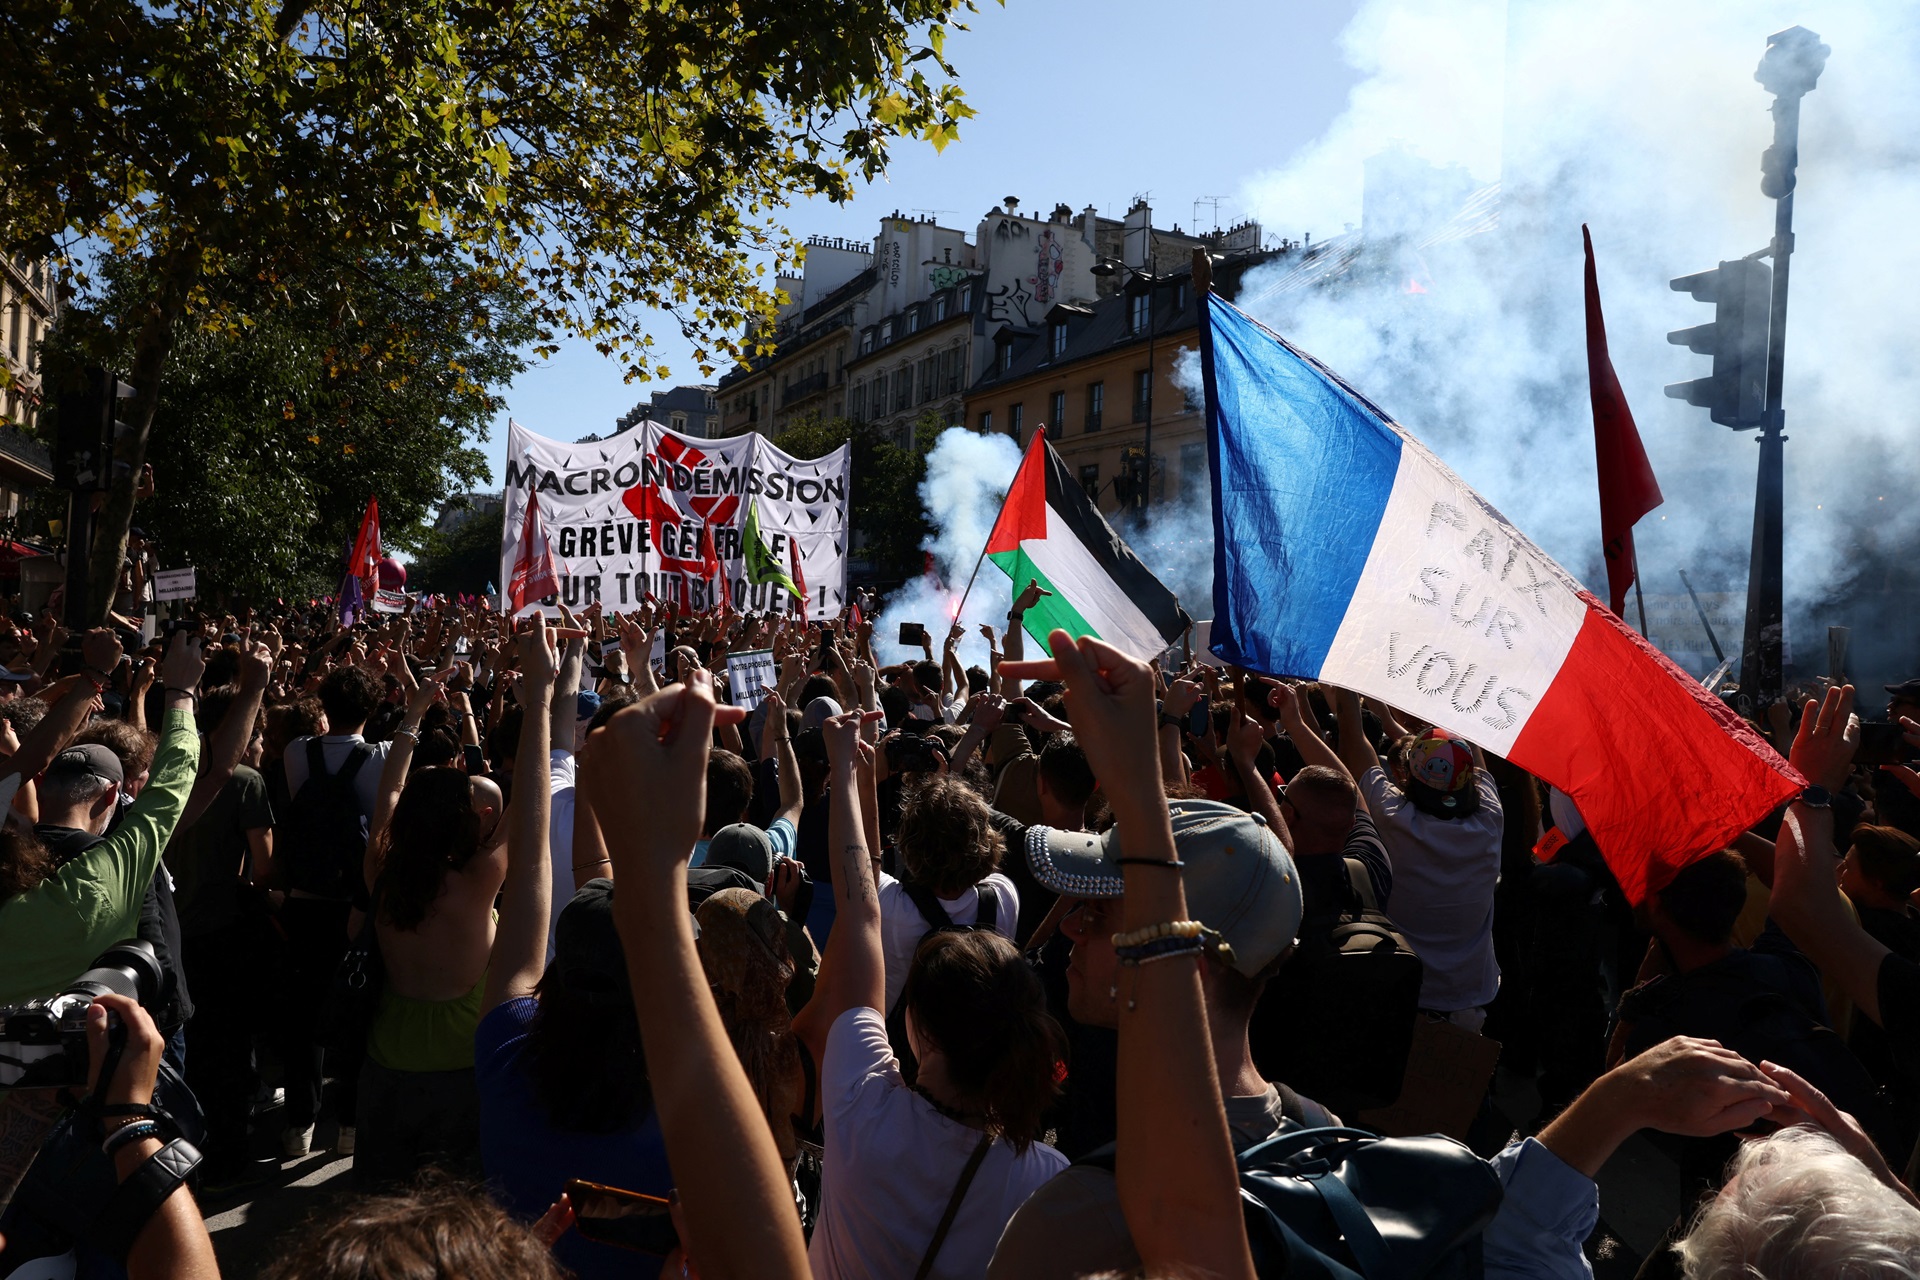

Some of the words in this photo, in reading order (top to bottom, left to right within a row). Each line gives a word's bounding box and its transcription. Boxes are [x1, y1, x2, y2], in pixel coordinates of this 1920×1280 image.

[506, 458, 665, 496] MACRON
[673, 459, 845, 504] DÉMISSION
[559, 520, 651, 558] GRÈVE
[663, 520, 786, 564] GÉÉRE
[1425, 501, 1556, 617] PAIX
[616, 572, 683, 606] TOUT
[817, 586, 826, 616] !
[1408, 566, 1528, 650] SUR
[1691, 600, 1720, 613] ays
[731, 662, 748, 672] NOTRE
[1387, 631, 1533, 731] VOUS
[735, 688, 768, 701] MILLIARDA
